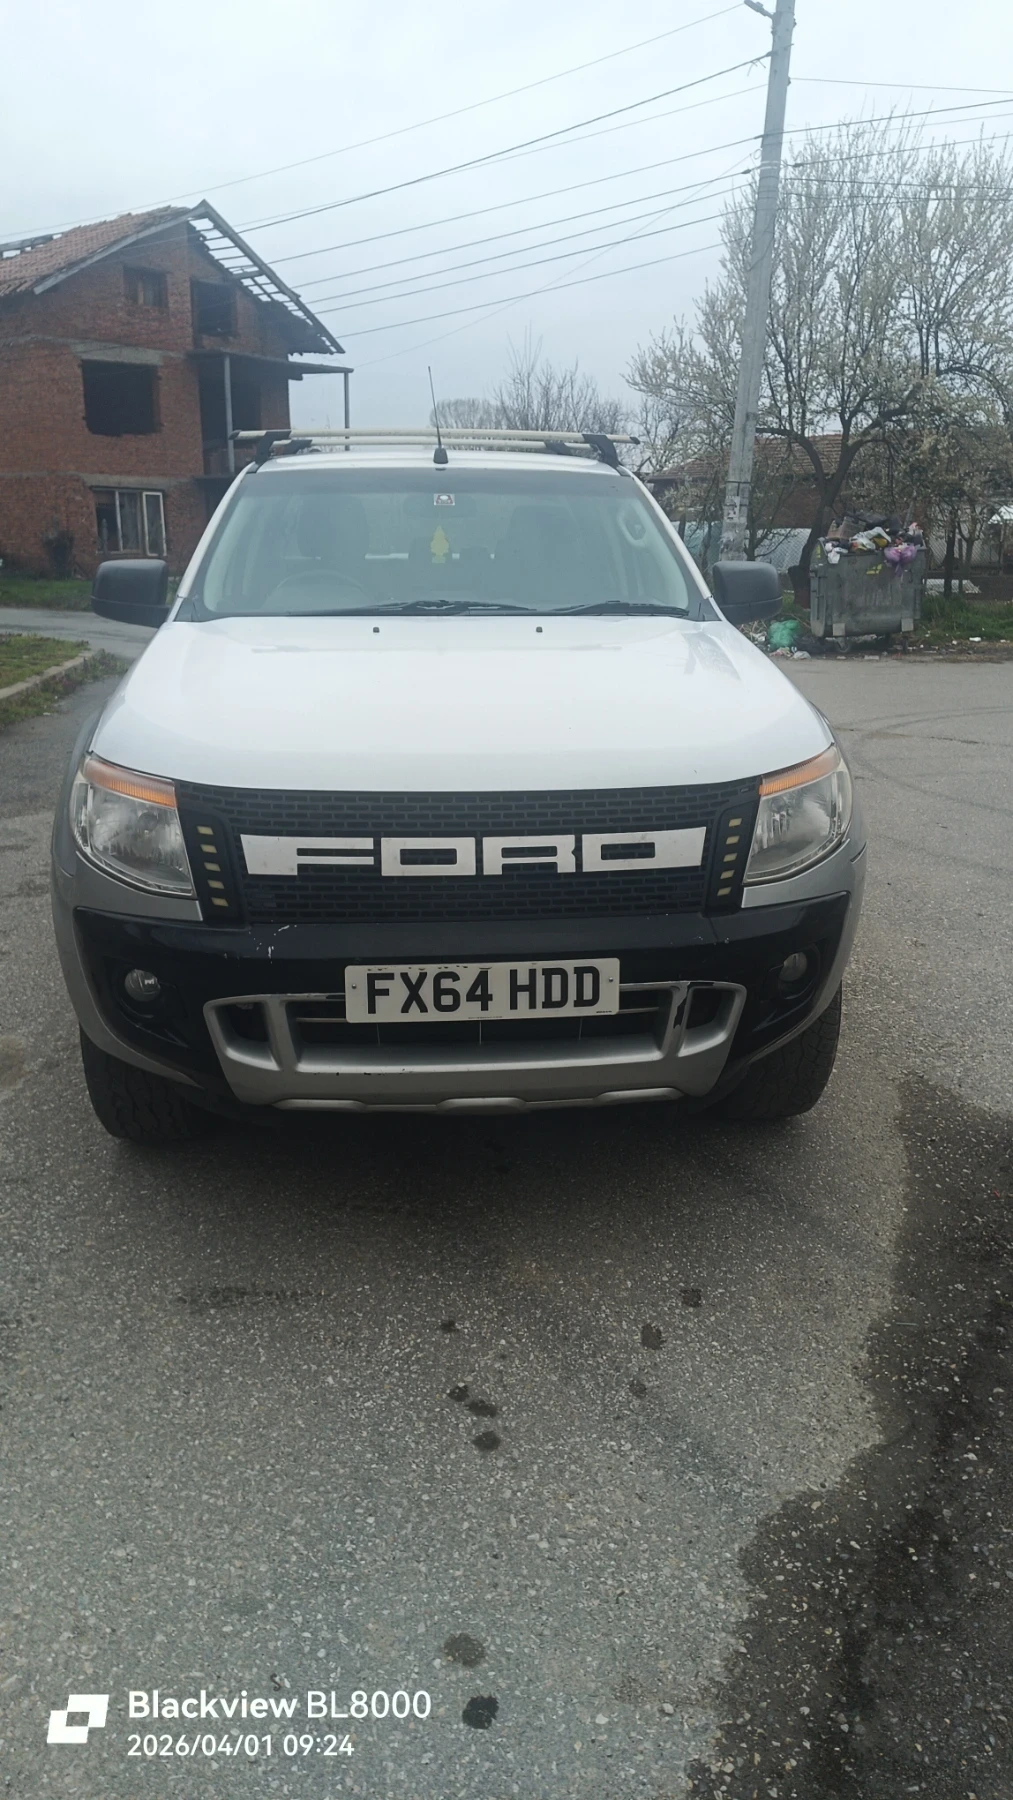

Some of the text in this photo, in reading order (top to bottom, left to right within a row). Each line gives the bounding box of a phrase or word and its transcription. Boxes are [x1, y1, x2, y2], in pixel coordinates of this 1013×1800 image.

[240, 827, 706, 876] FORD
[366, 966, 600, 1014] FX64 HDD
